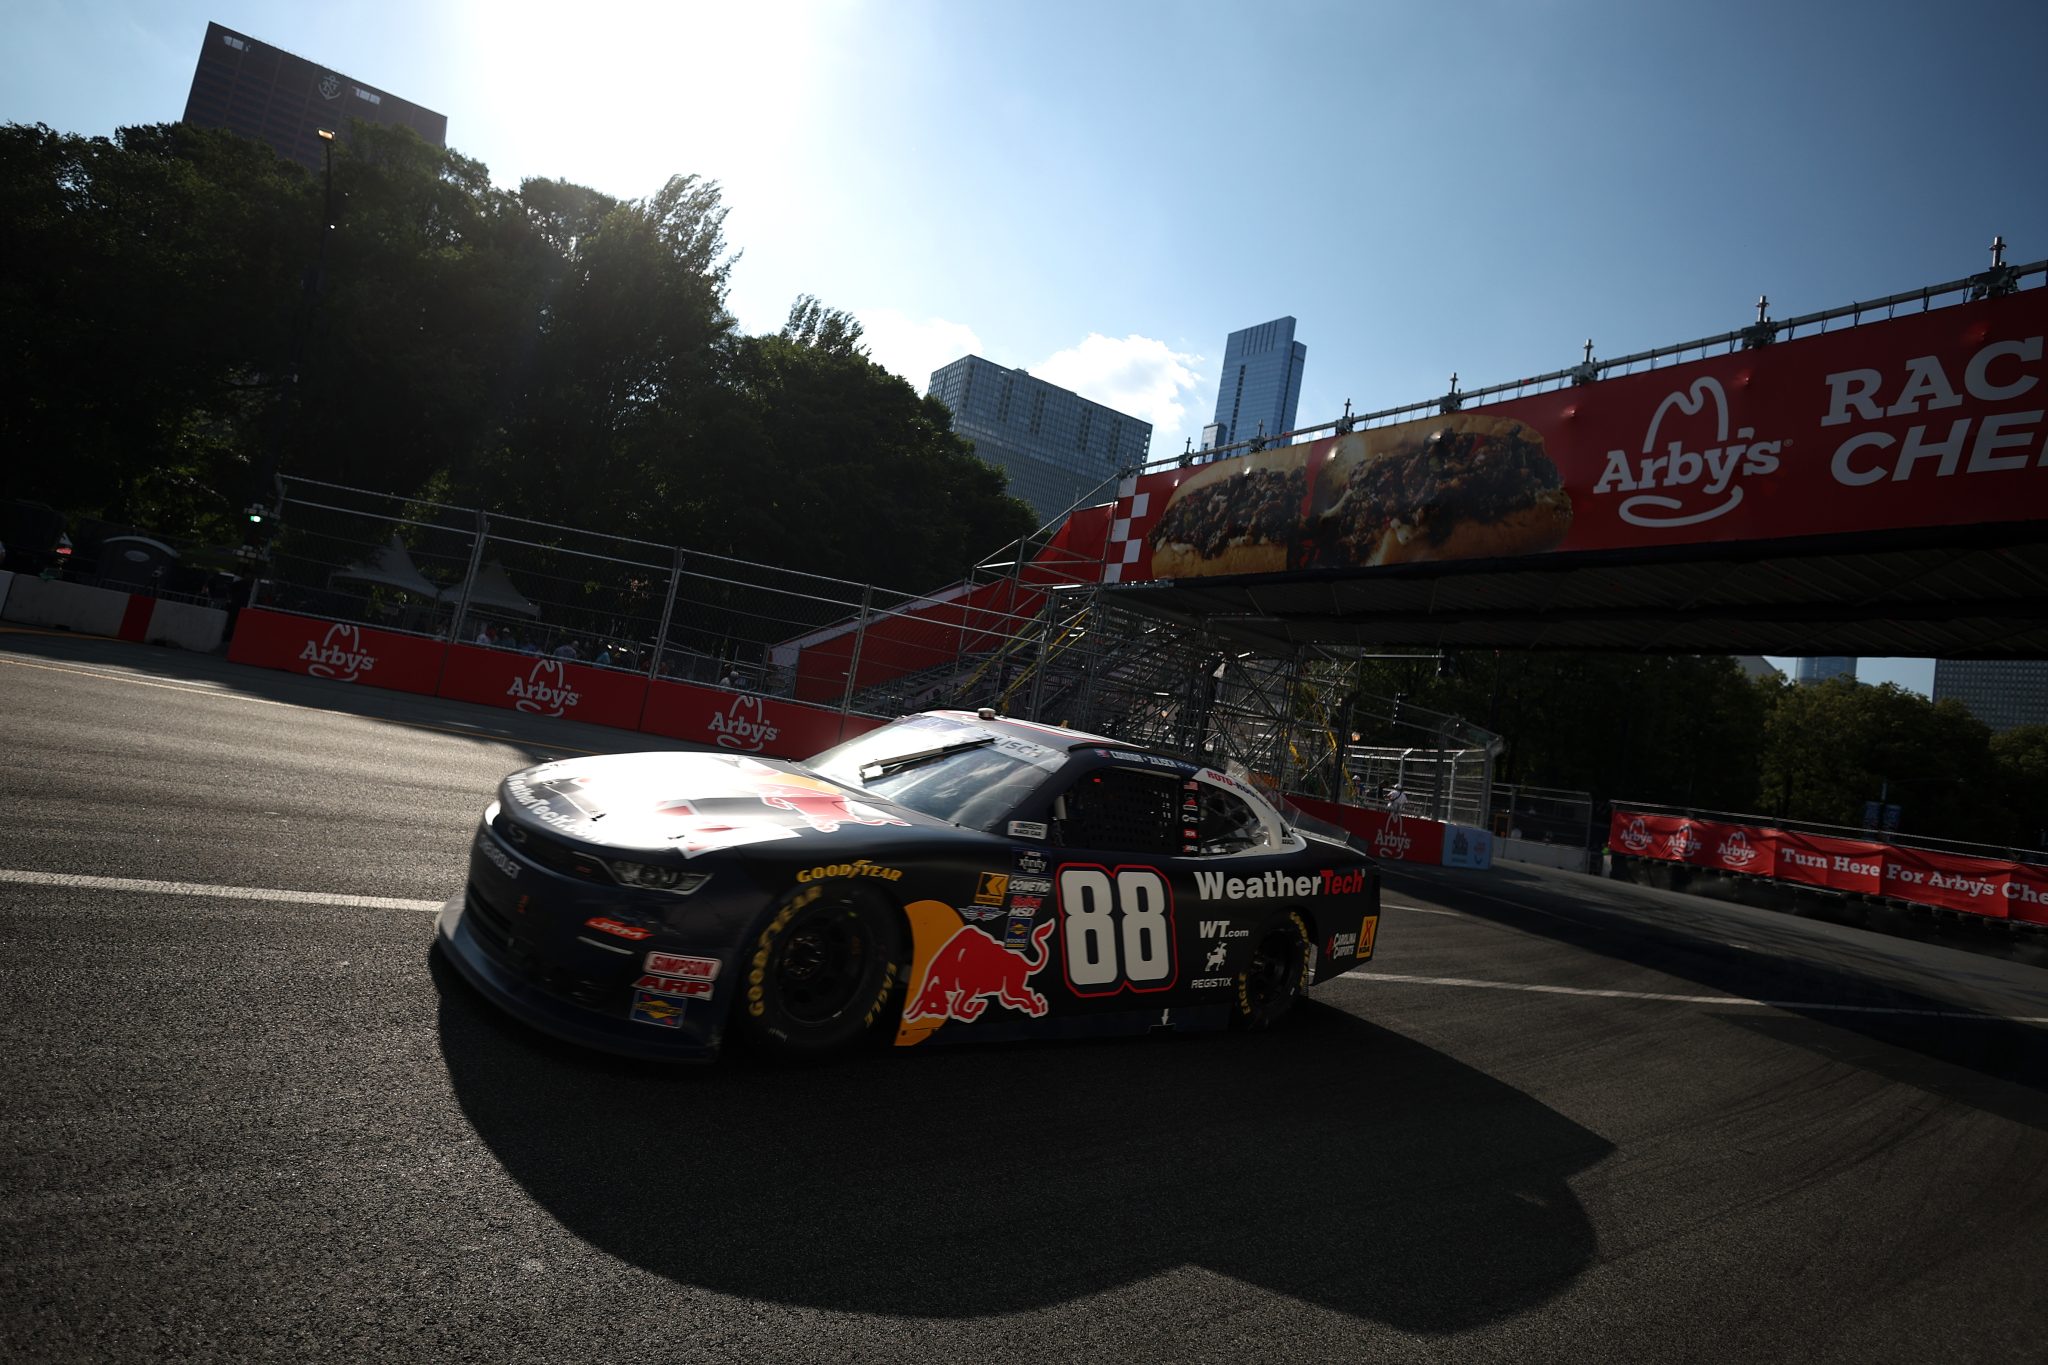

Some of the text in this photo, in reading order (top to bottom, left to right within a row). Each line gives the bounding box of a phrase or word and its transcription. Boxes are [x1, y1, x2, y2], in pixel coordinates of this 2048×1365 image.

[1820, 336, 2044, 426] RAC
[1593, 427, 1782, 495] Arby's
[1830, 409, 2048, 487] CHE
[299, 640, 375, 673] Arby's
[507, 676, 579, 708] Arby's
[708, 711, 778, 743] Arby's
[1374, 829, 1411, 850] Arby's
[1620, 830, 1654, 844] Arby's
[1667, 835, 1702, 853] Arby's
[1717, 841, 1757, 860] Arby's
[796, 857, 903, 883] GOODYEAR
[1782, 848, 1828, 869] Turn
[1833, 856, 1880, 877] Here
[1887, 864, 1924, 885] For
[1928, 871, 1994, 897] Arby's
[1193, 869, 1365, 901] WeatherTech
[1060, 869, 1170, 985] 88
[1200, 920, 1249, 939] WT.com
[651, 956, 714, 977] SIMPSON
[637, 979, 711, 995] ARP
[1191, 977, 1233, 989] REGISTIX
